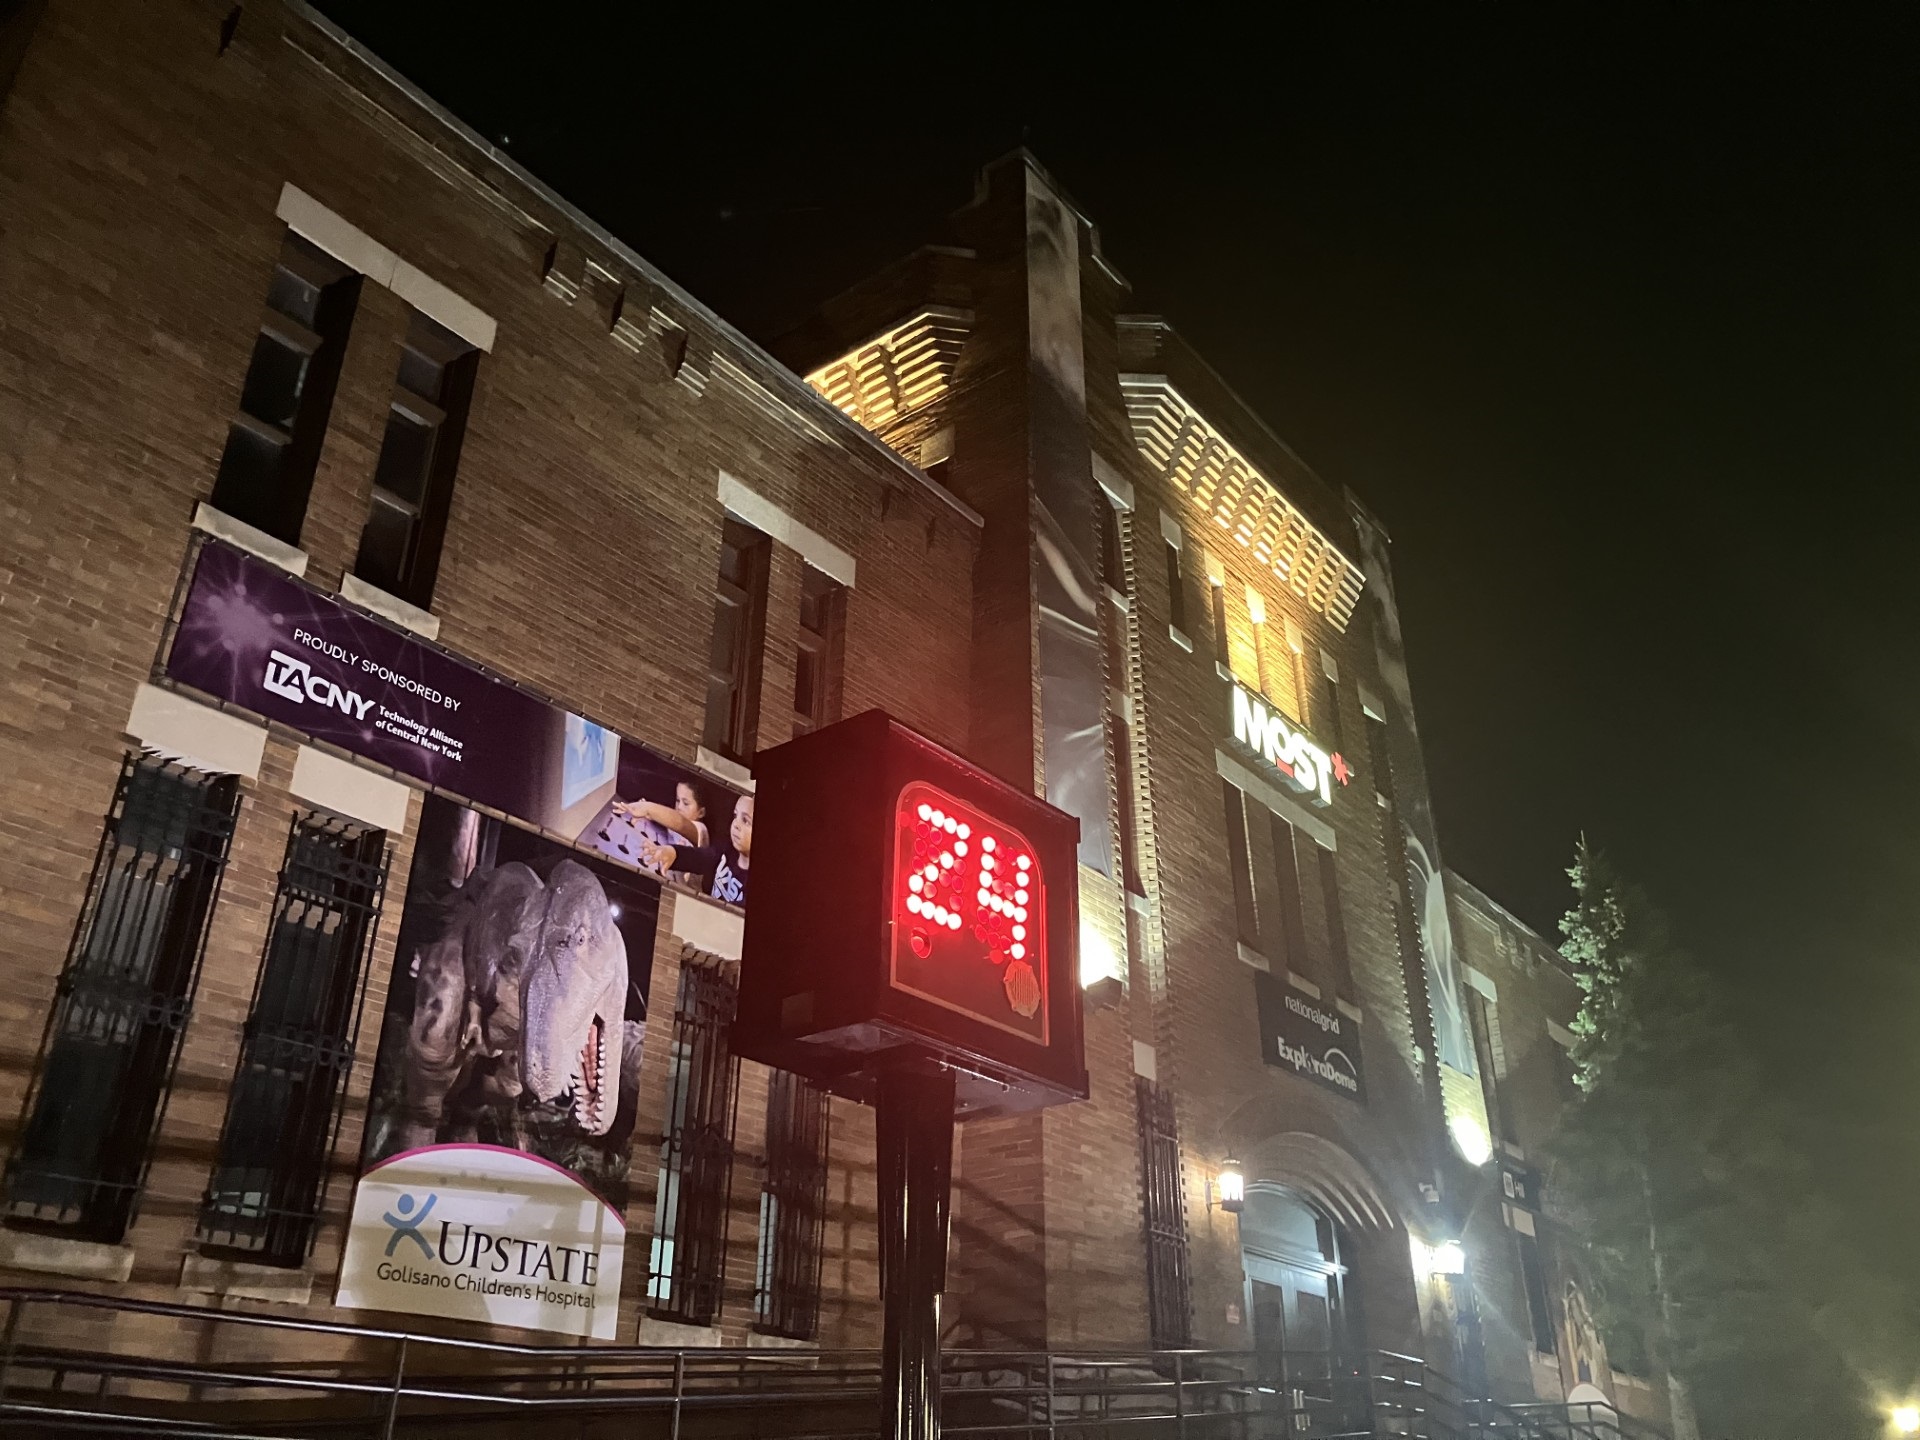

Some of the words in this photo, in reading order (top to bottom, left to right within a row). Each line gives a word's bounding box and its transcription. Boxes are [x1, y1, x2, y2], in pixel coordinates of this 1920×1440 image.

[263, 649, 376, 722] TACNY
[293, 628, 359, 667] PROUDLY
[361, 659, 442, 704] SPONSORED
[443, 696, 462, 712] BY
[375, 720, 387, 730] of
[386, 723, 420, 744] Central
[420, 736, 440, 752] New
[441, 745, 462, 762] York
[379, 705, 429, 736] Technology
[429, 728, 464, 749] Alliance
[906, 803, 1031, 960] 24
[1285, 996, 1340, 1035] nationalgrid
[377, 1262, 450, 1288] Golisano
[454, 1273, 532, 1299] Children's
[535, 1288, 595, 1310] Hospital
